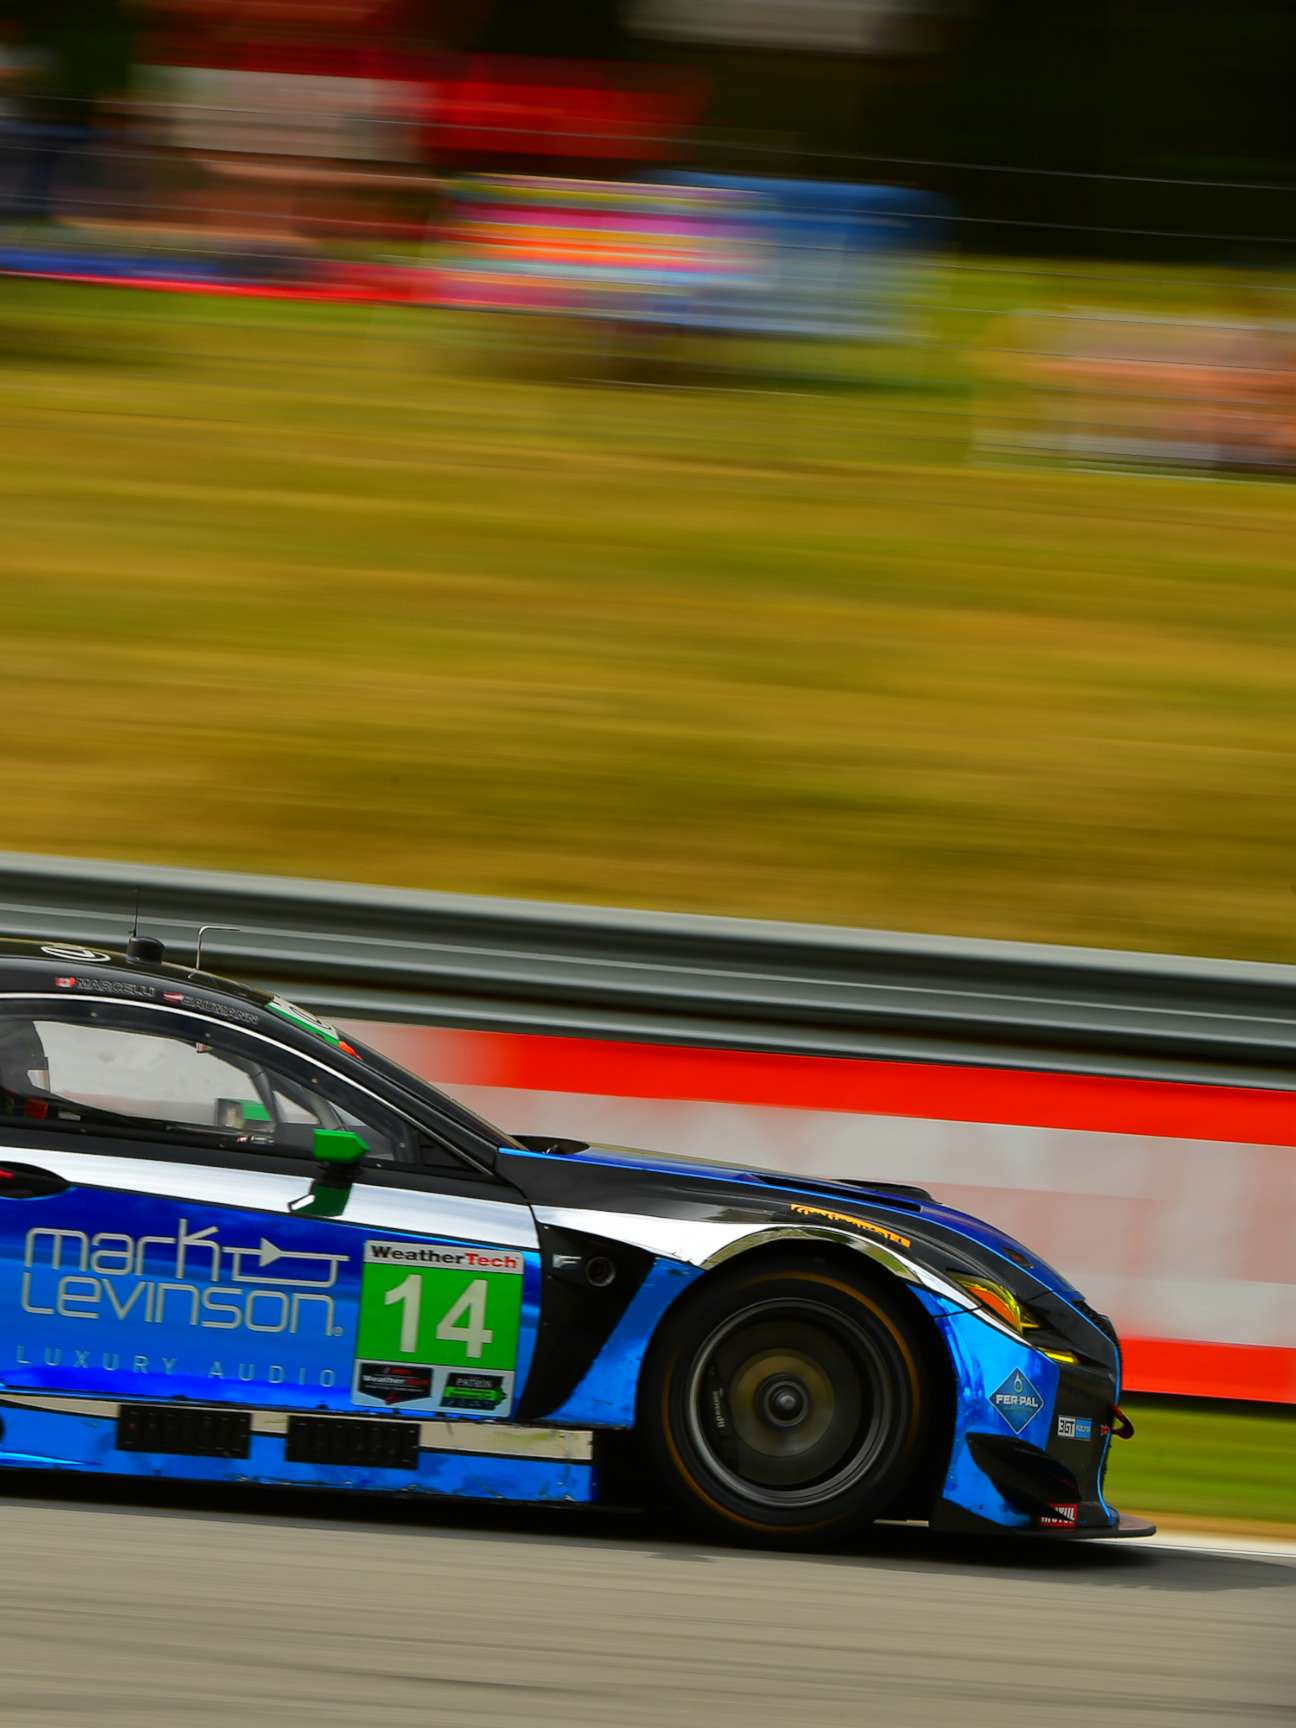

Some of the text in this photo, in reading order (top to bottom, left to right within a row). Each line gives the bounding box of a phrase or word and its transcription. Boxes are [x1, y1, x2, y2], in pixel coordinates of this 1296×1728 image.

[371, 1245, 517, 1269] WeatherTech
[384, 1274, 493, 1359] 14
[16, 1346, 337, 1388] LUXURY AUDIO
[363, 1375, 429, 1387] Weather
